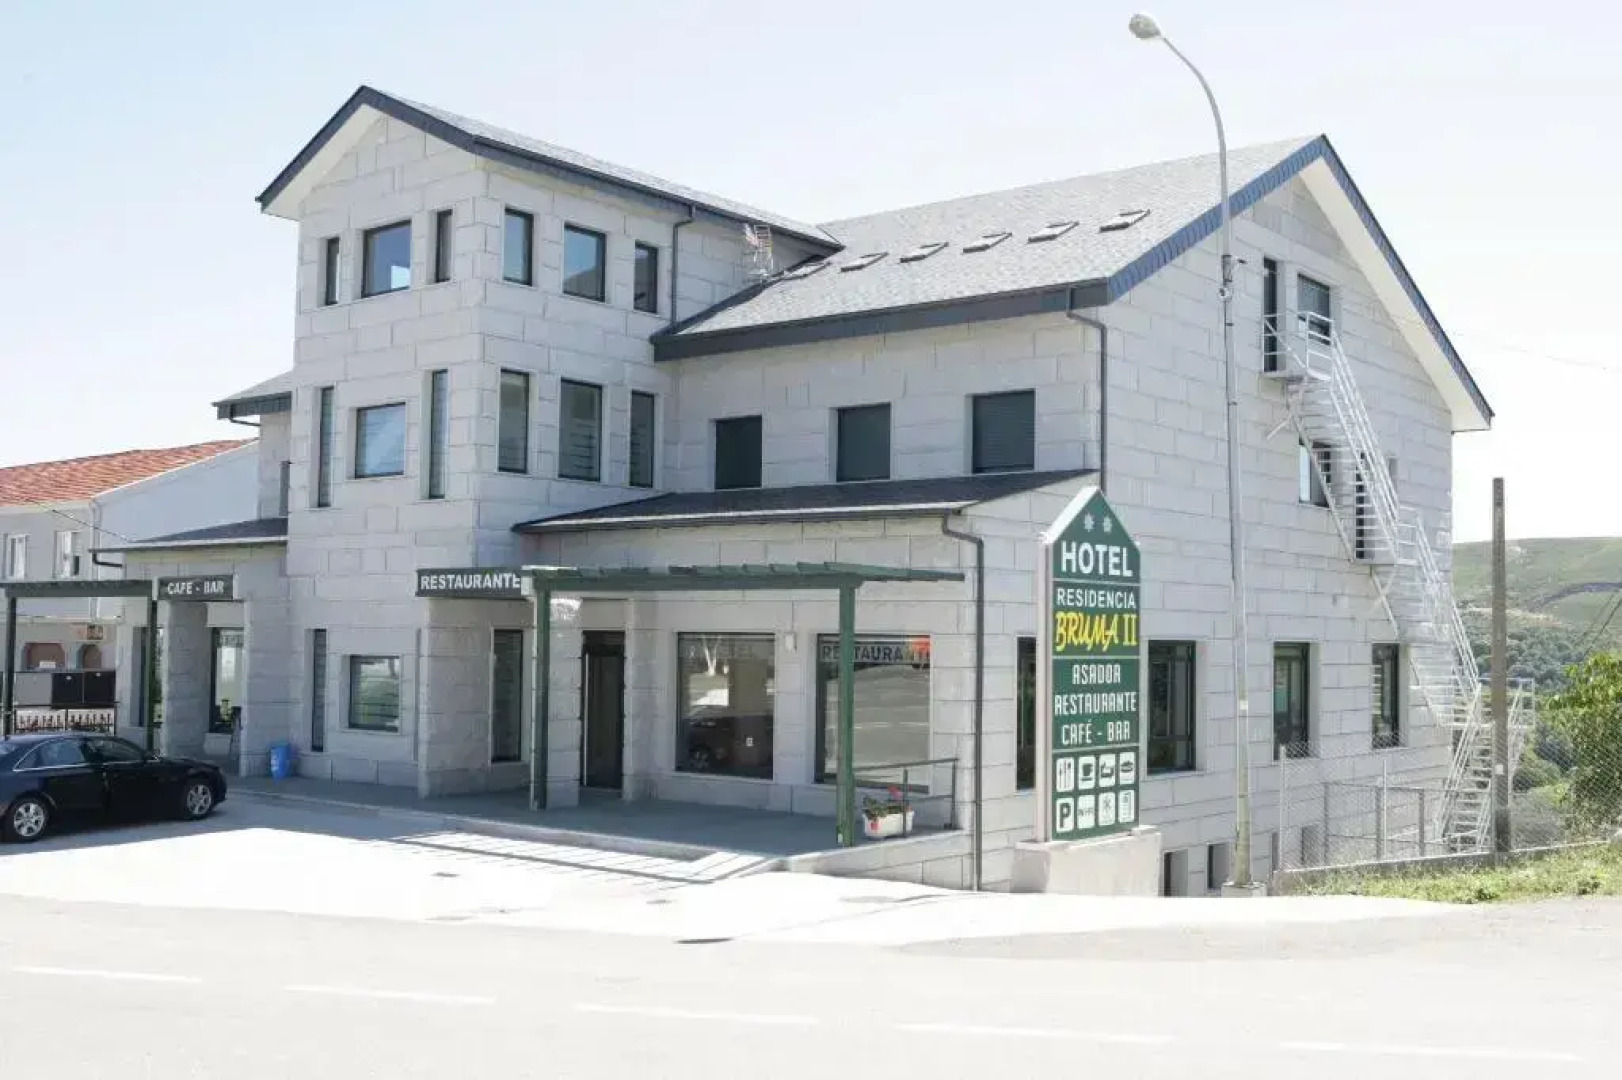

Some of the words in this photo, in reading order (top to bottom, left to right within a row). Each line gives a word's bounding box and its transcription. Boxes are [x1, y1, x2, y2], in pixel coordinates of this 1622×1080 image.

[1060, 540, 1134, 577] HOTEL
[203, 580, 224, 595] BAR
[420, 572, 521, 590] RESTAURANTE
[1057, 588, 1137, 609] RESIDENCIA
[1055, 610, 1119, 652] BRUMA
[1123, 613, 1137, 647] II
[1072, 664, 1121, 685] ASADOR
[1054, 691, 1137, 716] RESTAURANTE
[1061, 719, 1092, 745] CAFÉ
[1107, 720, 1130, 742] BAR
[1059, 802, 1071, 829] P
